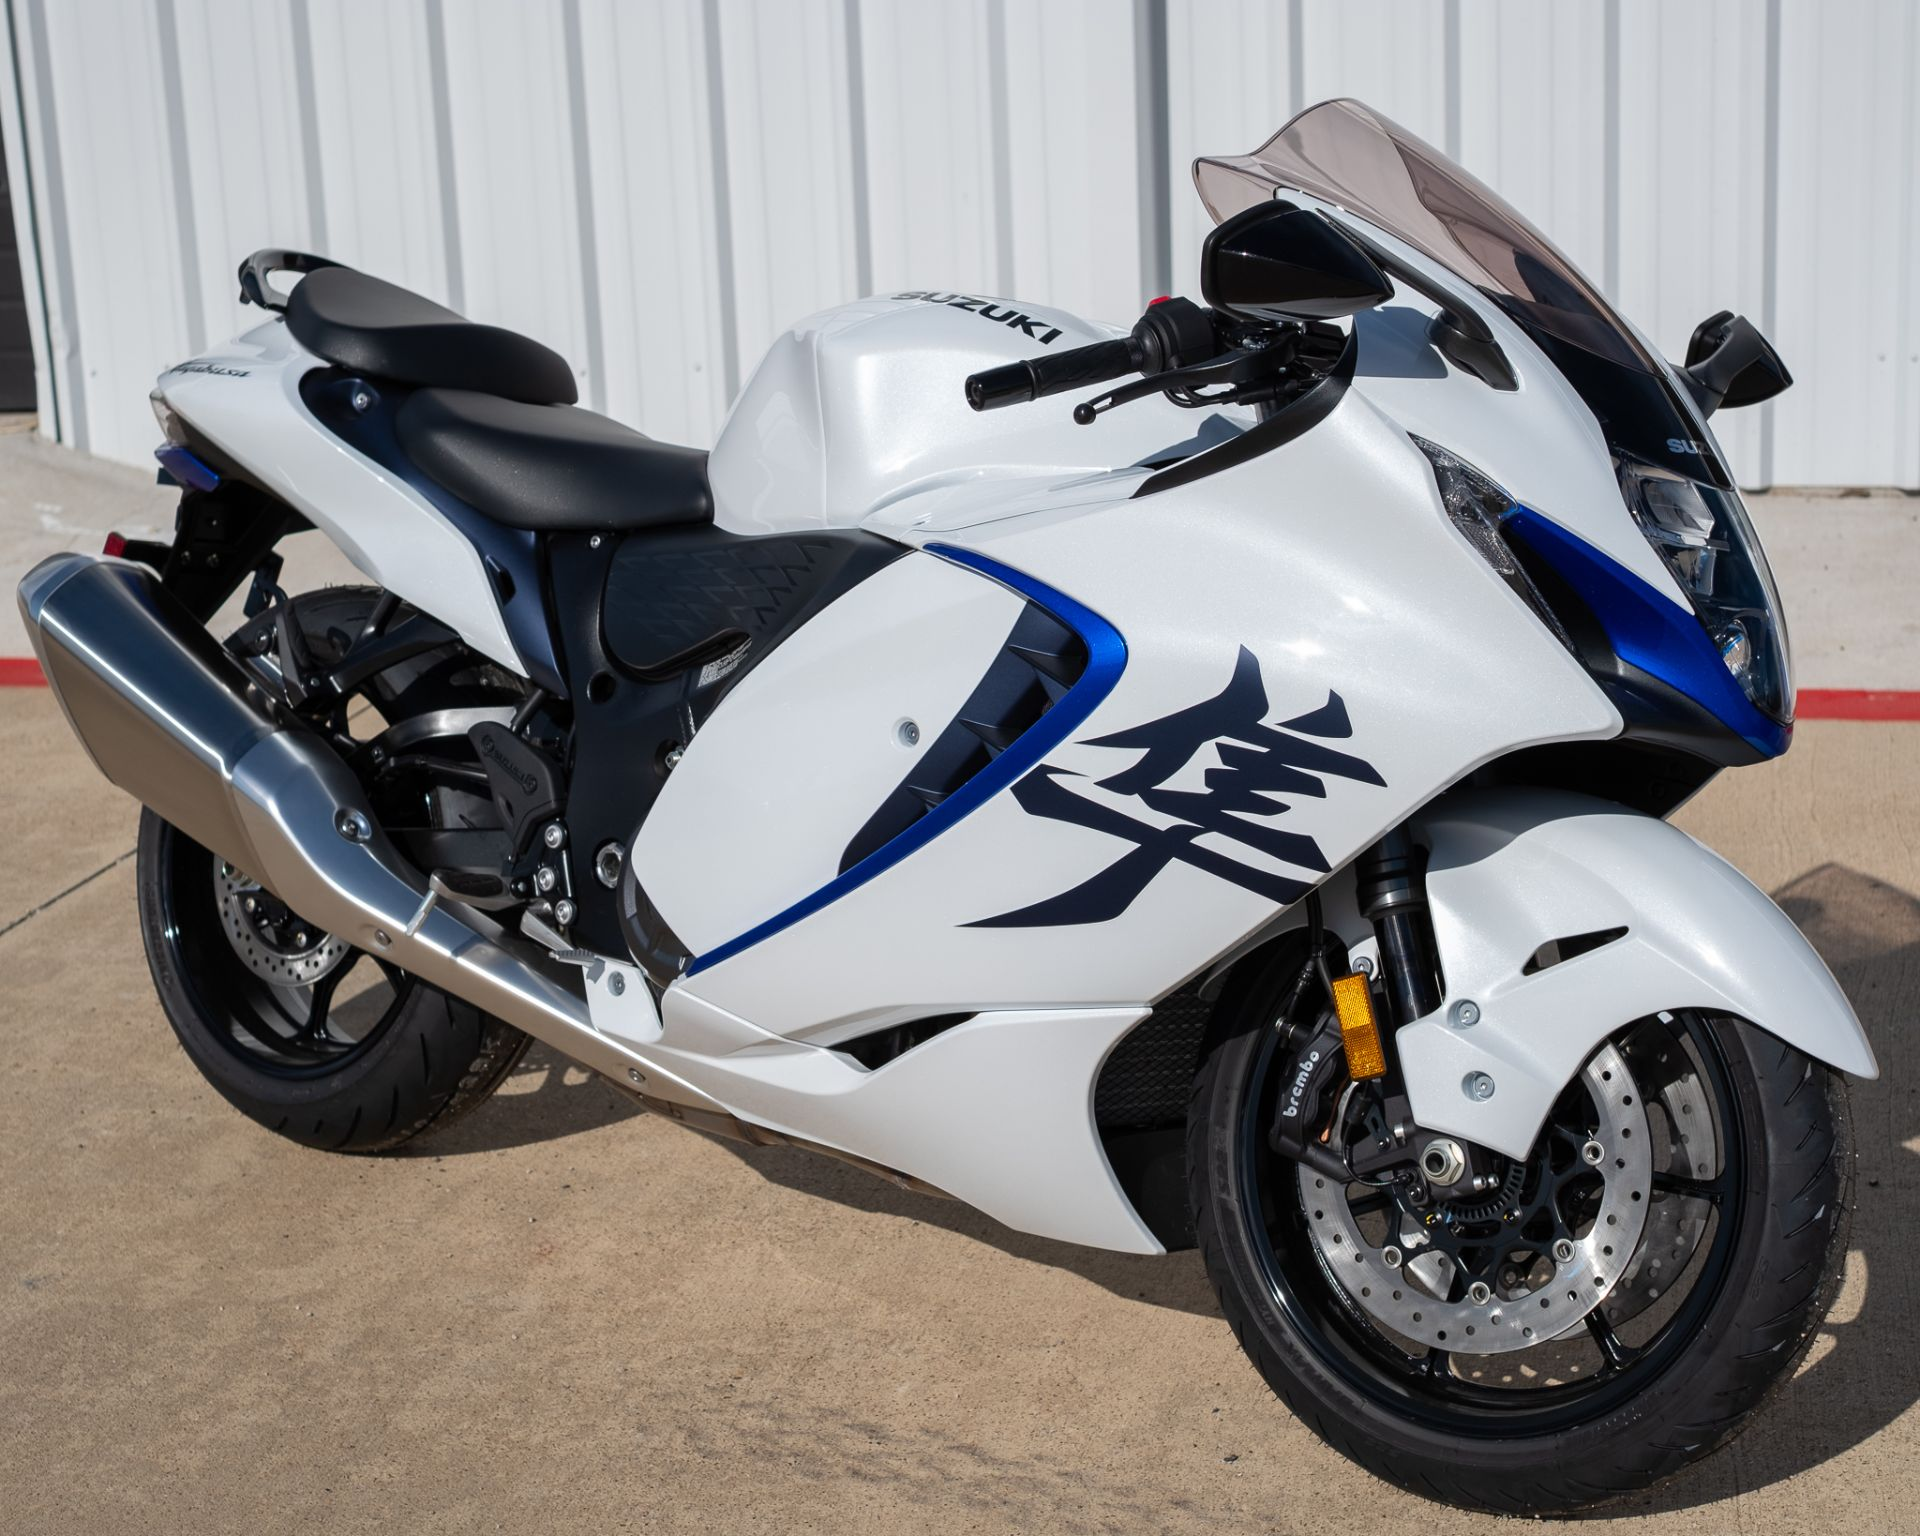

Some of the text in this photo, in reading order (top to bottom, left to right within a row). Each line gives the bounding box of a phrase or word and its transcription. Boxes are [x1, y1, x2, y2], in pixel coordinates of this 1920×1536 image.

[891, 291, 1064, 345] SUZUKI
[953, 643, 1389, 929] 隼
[1282, 1050, 1320, 1118] brembo
